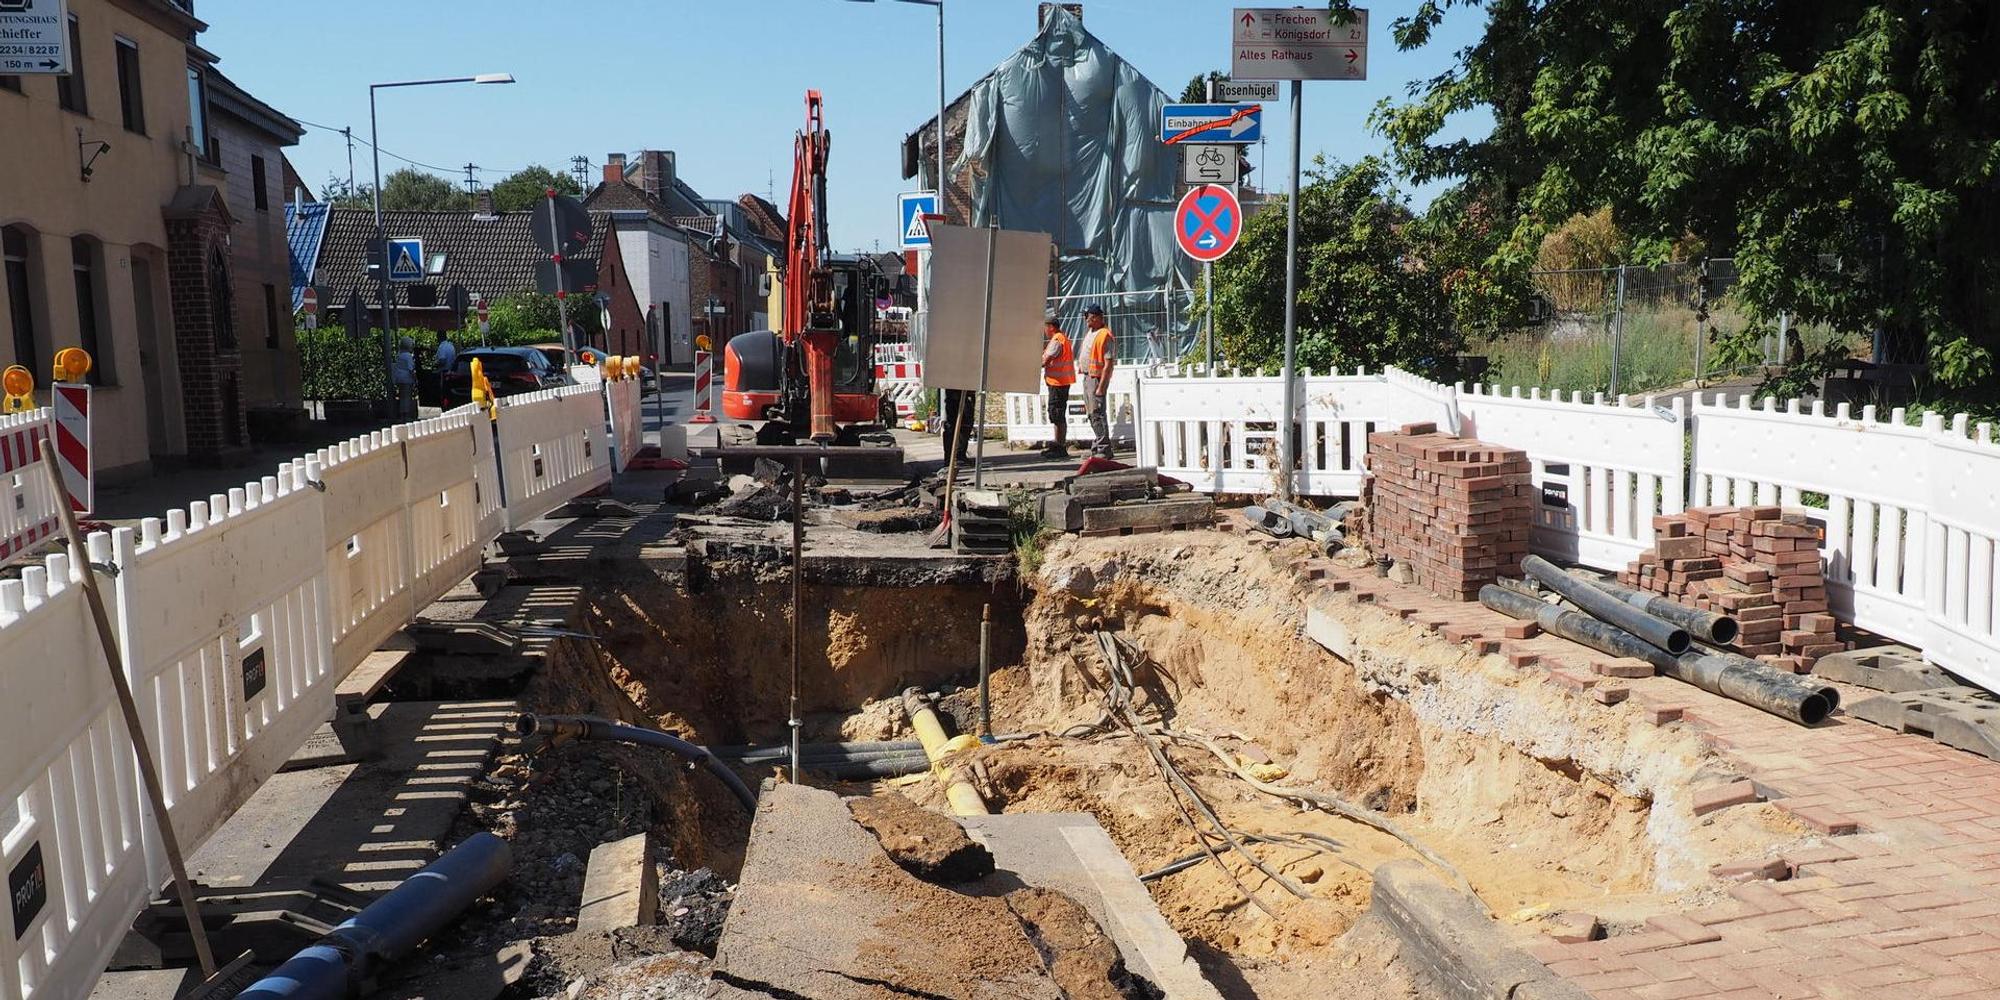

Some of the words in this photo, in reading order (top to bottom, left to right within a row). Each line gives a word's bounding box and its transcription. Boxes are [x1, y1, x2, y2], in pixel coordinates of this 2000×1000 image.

[1275, 14, 1317, 25] Frechen
[0, 28, 41, 39] hieffer
[1275, 29, 1331, 41] Königsdorf
[1240, 50, 1266, 60] Altes
[1272, 50, 1313, 60] Rathaus
[5, 60, 21, 68] 150
[1219, 84, 1276, 98] Rosenhügel
